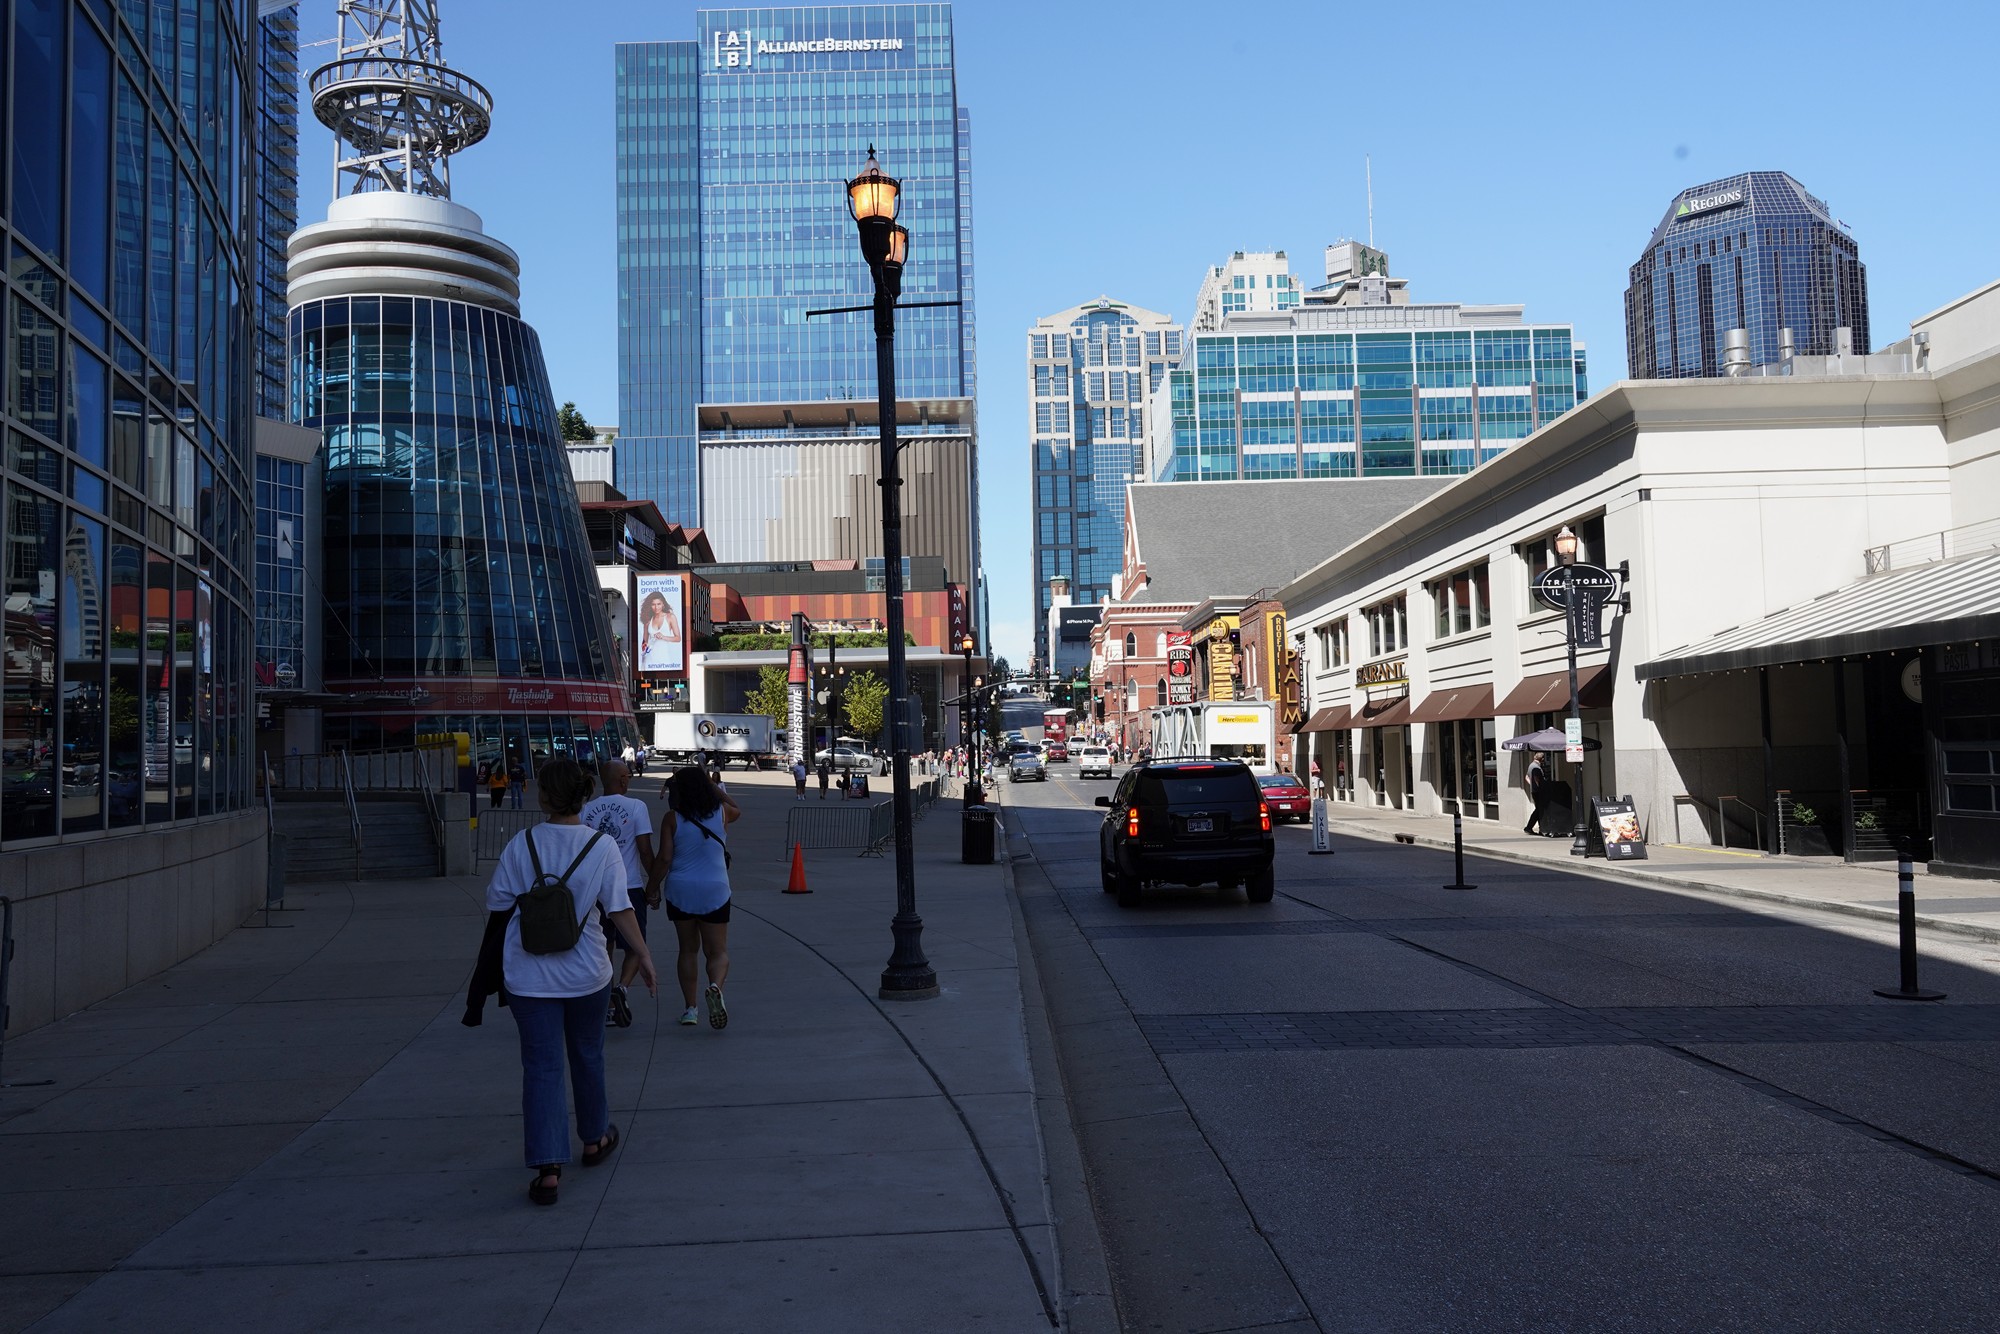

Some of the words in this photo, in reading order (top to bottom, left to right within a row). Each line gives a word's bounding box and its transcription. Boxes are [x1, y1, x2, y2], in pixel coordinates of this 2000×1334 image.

[726, 30, 740, 45] A
[758, 38, 902, 53] ALLIANCEBERNSTEIN
[727, 51, 740, 66] B
[1690, 190, 1742, 212] REGIONS
[659, 578, 675, 586] with
[1169, 650, 1191, 660] RIBS
[1943, 652, 1970, 671] PASTA
[1211, 644, 1233, 701] CANTIN
[1283, 649, 1302, 724] PALM
[717, 727, 750, 735] athens
[586, 803, 606, 821] WILD
[610, 802, 629, 819] CATS
